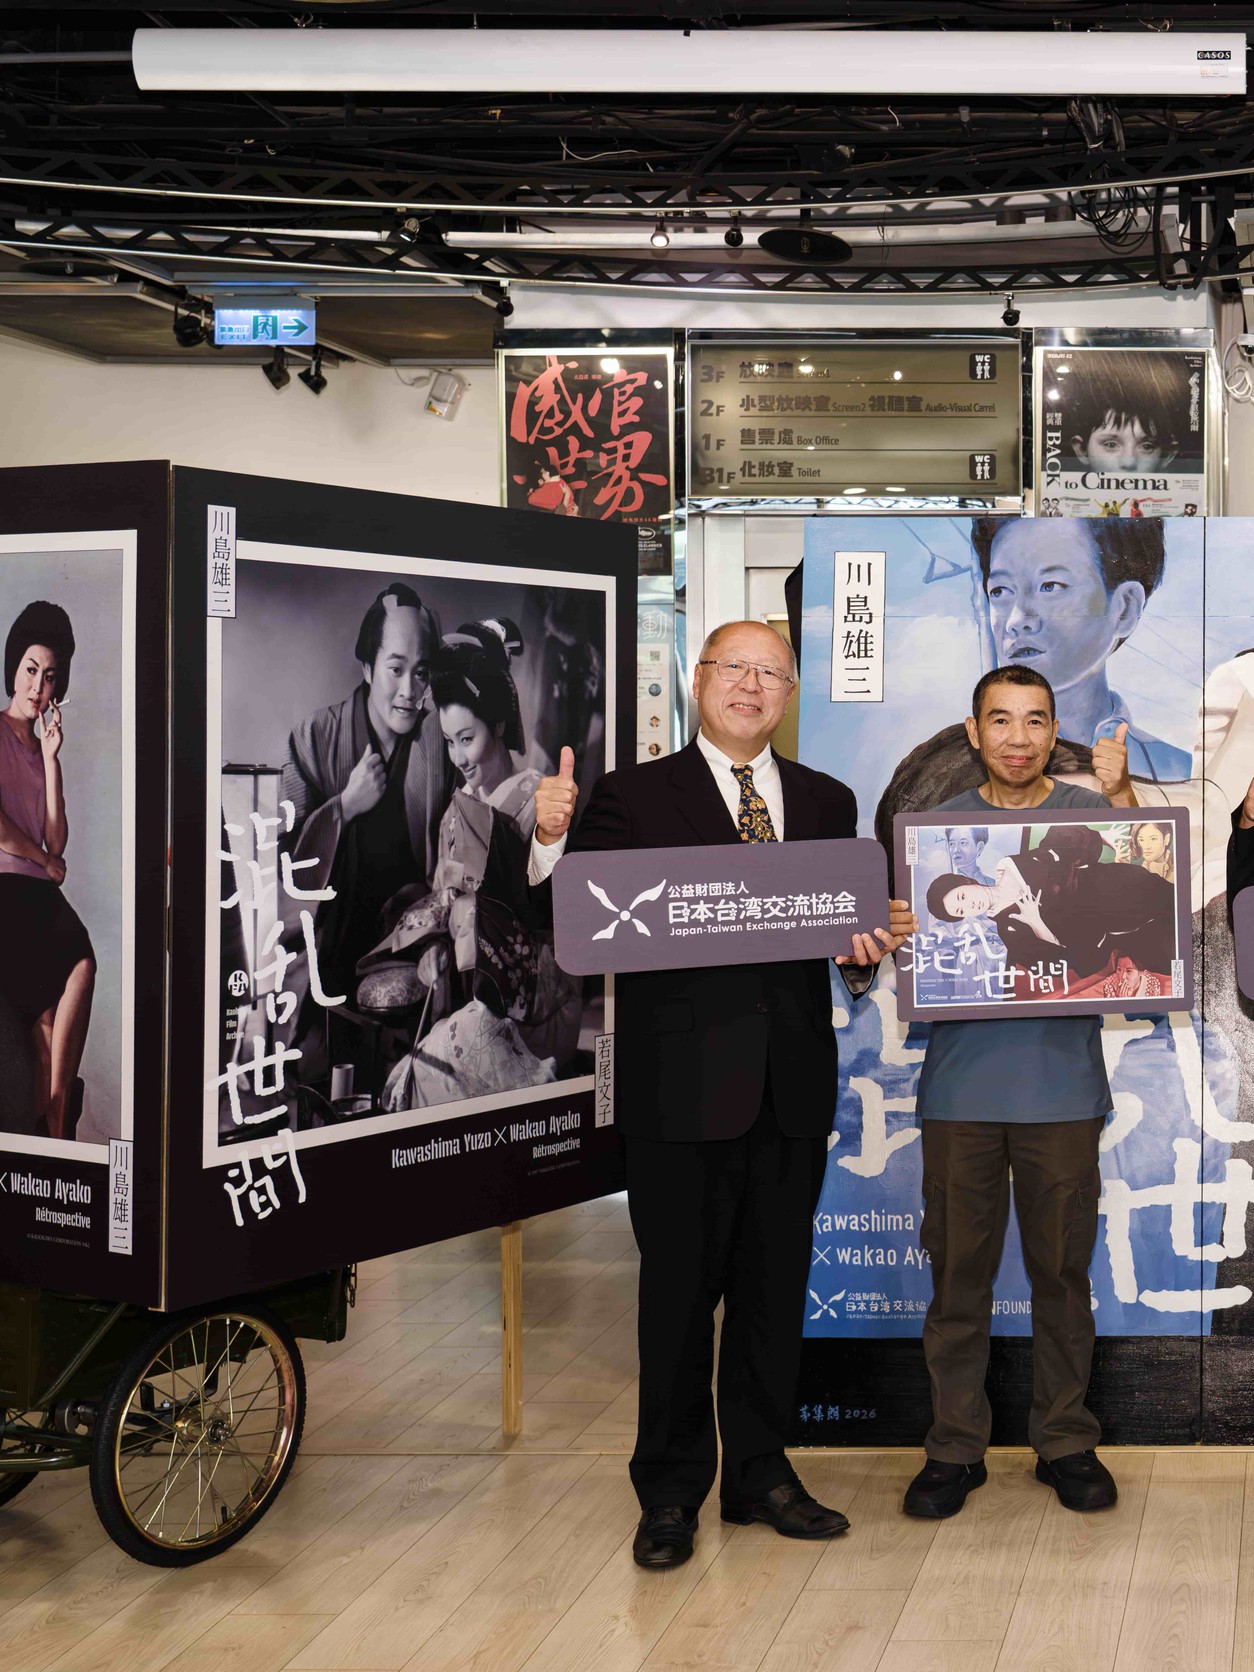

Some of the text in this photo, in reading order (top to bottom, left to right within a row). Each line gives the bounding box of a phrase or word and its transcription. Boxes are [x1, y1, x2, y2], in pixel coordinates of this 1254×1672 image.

[1197, 51, 1231, 59] CASOS
[700, 365, 725, 383] 3F
[974, 354, 991, 362] WC
[700, 399, 725, 417] 2F
[739, 394, 831, 412] 小型放映室
[832, 402, 866, 412] Screen2
[924, 402, 973, 412] Audio-Visual
[701, 428, 840, 451] 1F 售票處 Box Office
[700, 455, 991, 484] B1F 化妝室 Toilet WC
[1046, 430, 1062, 488] BACK
[1064, 480, 1079, 490] to
[1080, 471, 1170, 491] Cinema
[212, 510, 231, 612] 川島雄三
[638, 610, 668, 640] 動
[841, 561, 874, 694] 川島雄三
[667, 881, 750, 899] 公益財団法人
[668, 891, 857, 924] 日本台湾交流協会
[670, 915, 859, 937] Japan-Taiwan Exchange Association
[598, 1038, 611, 1124] 若尾文子
[391, 1137, 461, 1169] Kawashima
[463, 1130, 492, 1153] Yuzo
[509, 1118, 546, 1143] Wakao
[549, 1109, 581, 1137] Ayako
[533, 1137, 581, 1159] Rétrospective
[10, 1172, 92, 1205] Wakao Ayako
[112, 1145, 129, 1249] 川島雄三
[35, 1206, 91, 1229] Rétrospective
[813, 1208, 915, 1235] Kawashima
[844, 1408, 877, 1420] 2026
